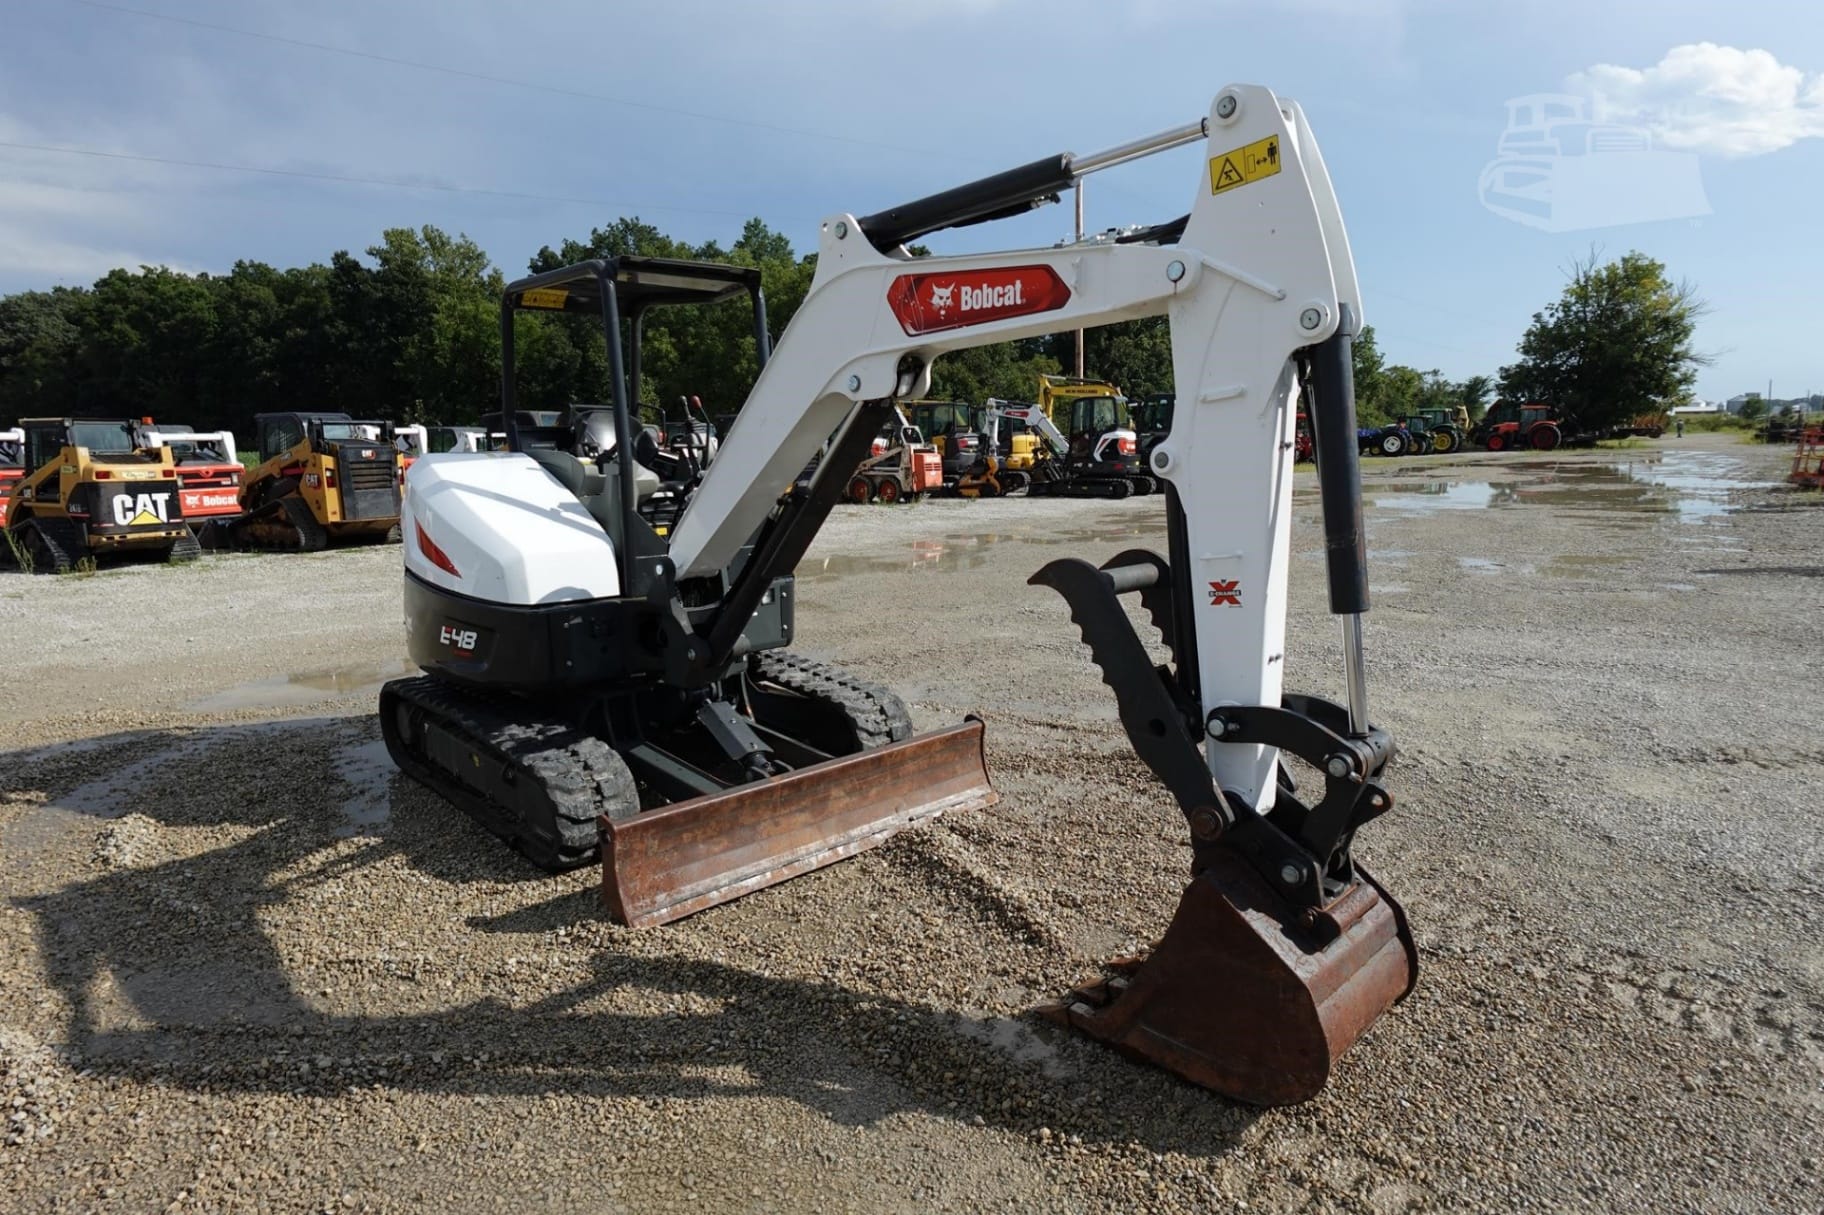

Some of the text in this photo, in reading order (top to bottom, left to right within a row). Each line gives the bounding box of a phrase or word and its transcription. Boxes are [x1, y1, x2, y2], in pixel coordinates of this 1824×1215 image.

[960, 279, 1022, 311] Bobcat
[305, 474, 319, 487] CAT
[112, 492, 171, 526] CAT
[202, 494, 238, 507] Bobcat
[440, 626, 477, 650] E48
